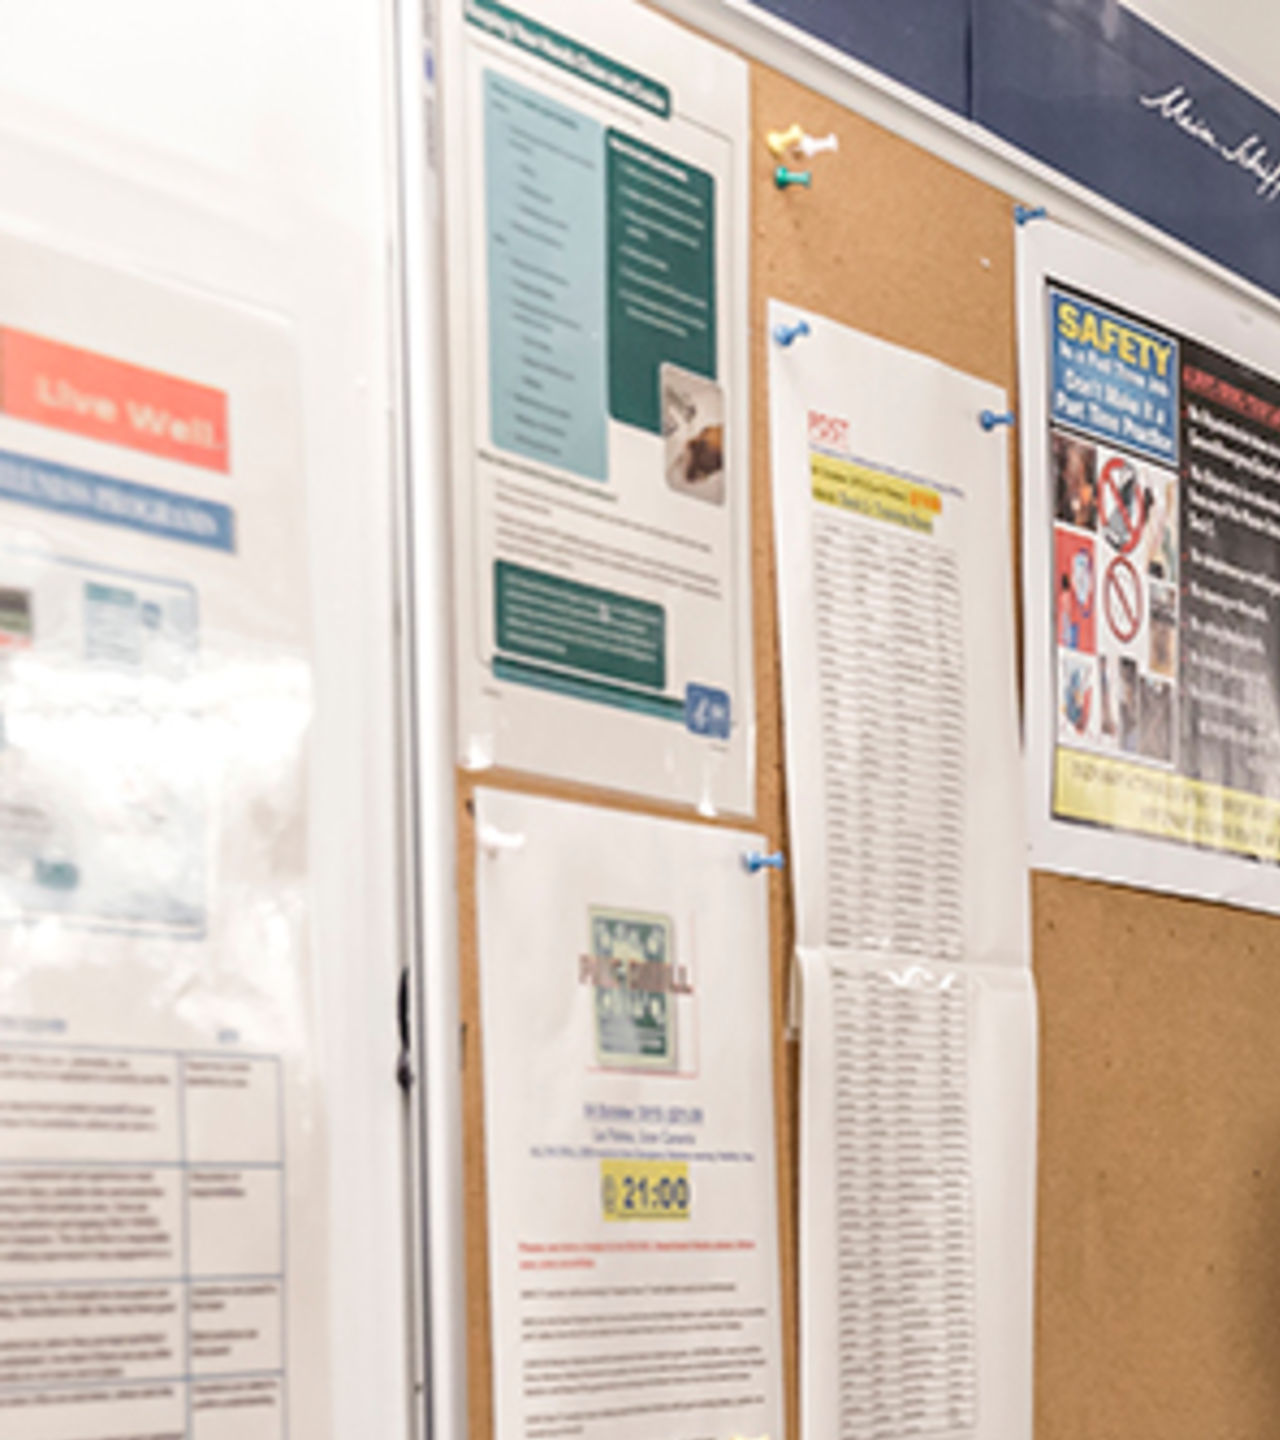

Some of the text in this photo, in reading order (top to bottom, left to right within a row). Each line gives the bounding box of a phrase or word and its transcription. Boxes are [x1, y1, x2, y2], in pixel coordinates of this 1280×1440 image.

[1057, 302, 1172, 377] SAFETY
[34, 372, 119, 424] Live
[622, 1174, 691, 1211] 21:00
